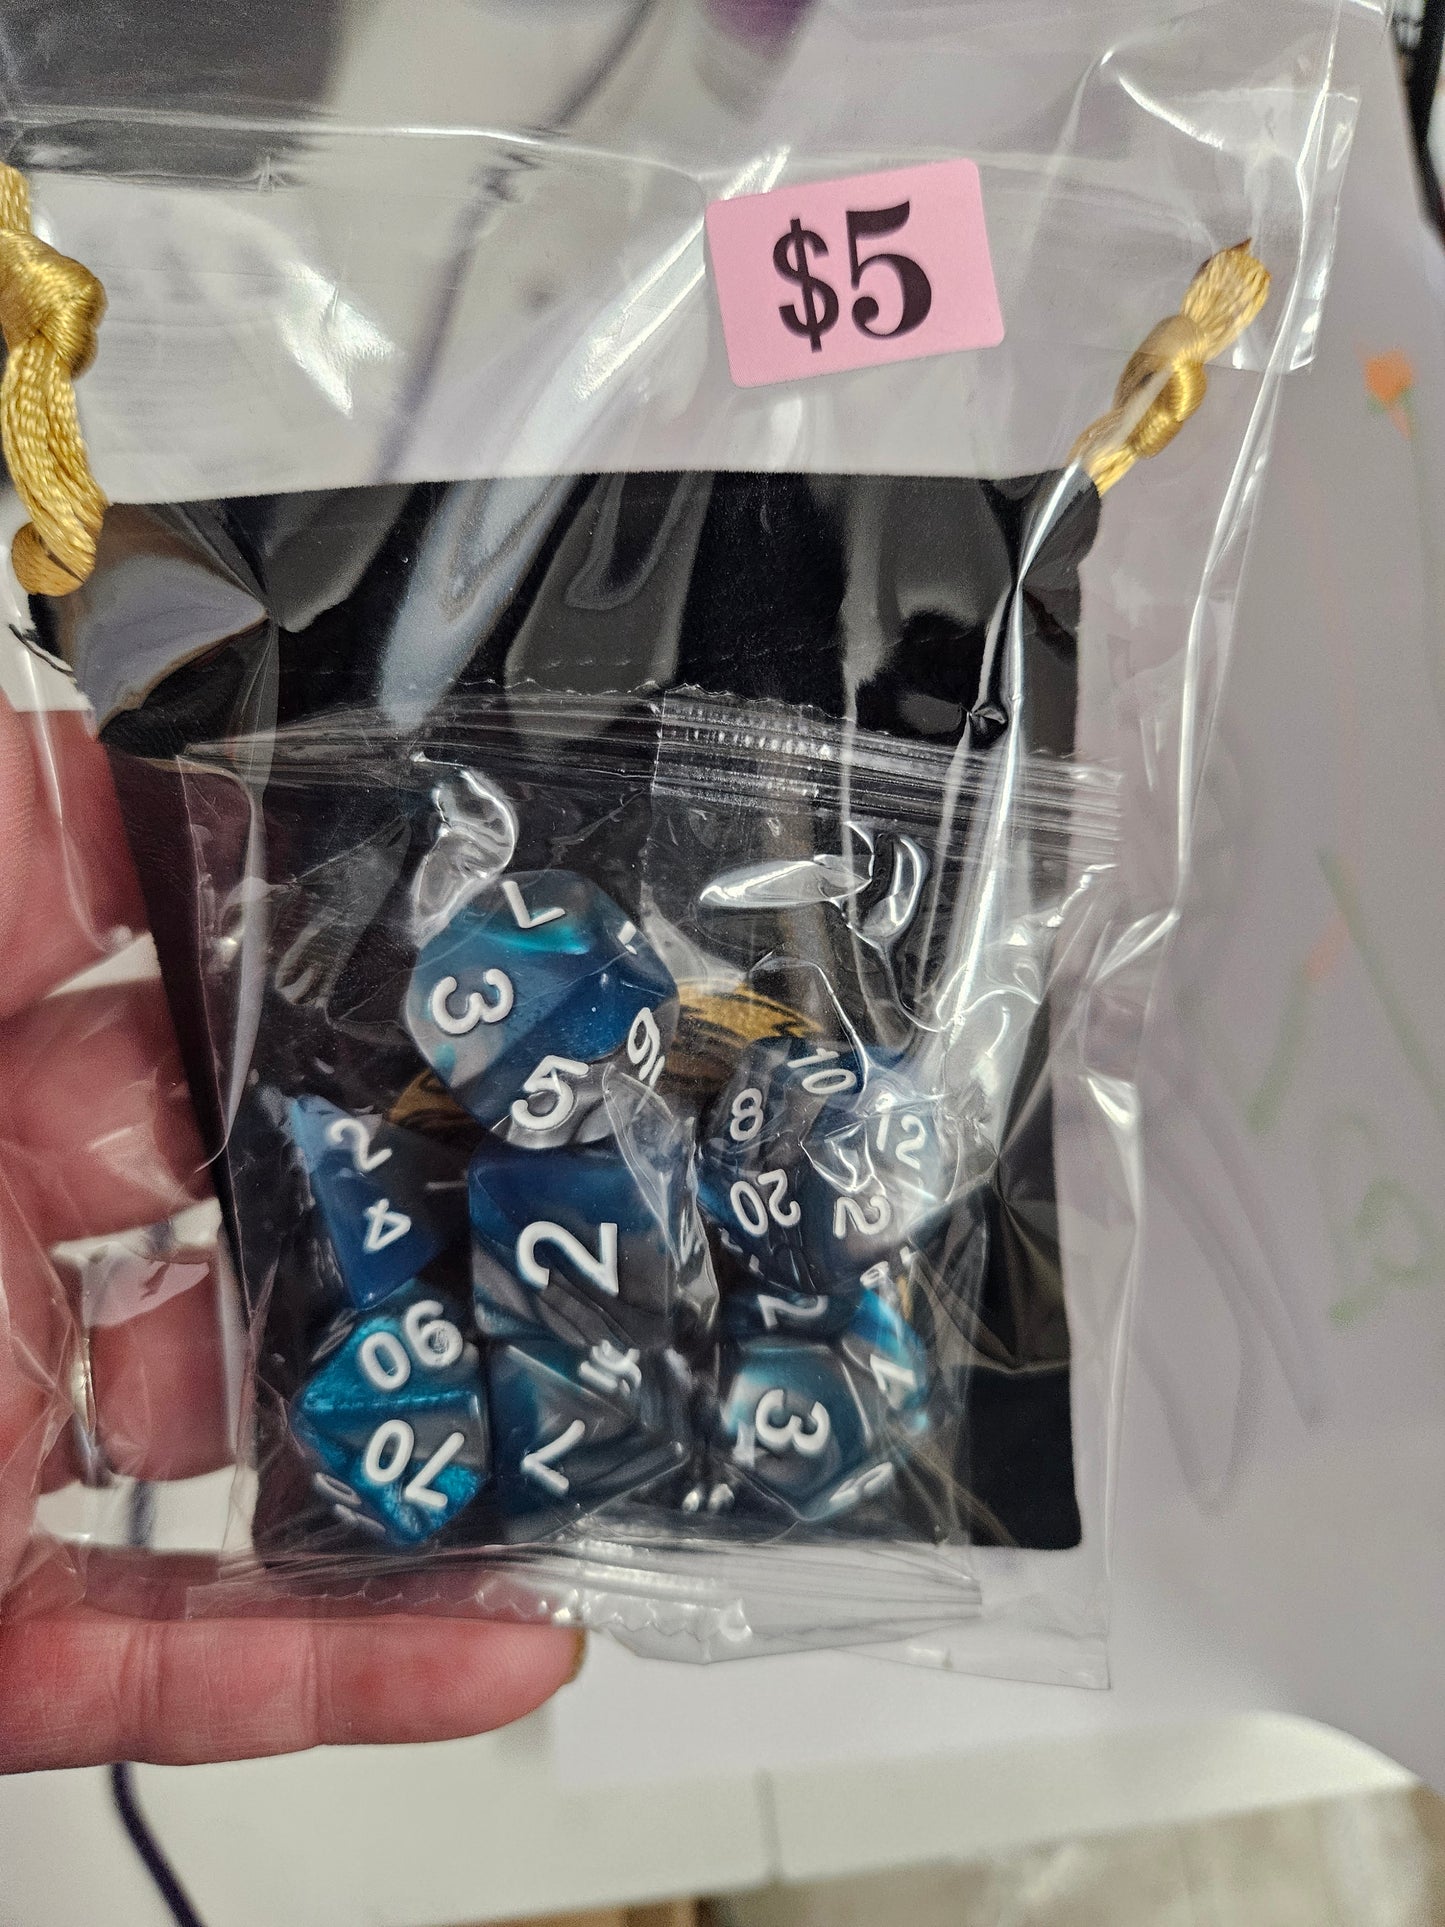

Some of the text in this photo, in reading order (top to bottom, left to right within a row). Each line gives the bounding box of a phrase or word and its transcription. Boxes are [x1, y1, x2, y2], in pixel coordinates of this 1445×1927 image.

[773, 200, 932, 353] $5
[431, 968, 514, 1036] 3
[511, 1054, 590, 1132] 5
[786, 1047, 858, 1096] 10
[326, 1116, 394, 1172] 2
[729, 1087, 764, 1142] 8
[873, 1090, 927, 1171] 12
[362, 1198, 412, 1254] 4
[730, 1168, 802, 1236] 20
[516, 1220, 620, 1297] 2
[754, 1388, 831, 1454] 3
[363, 1418, 465, 1508] 70
